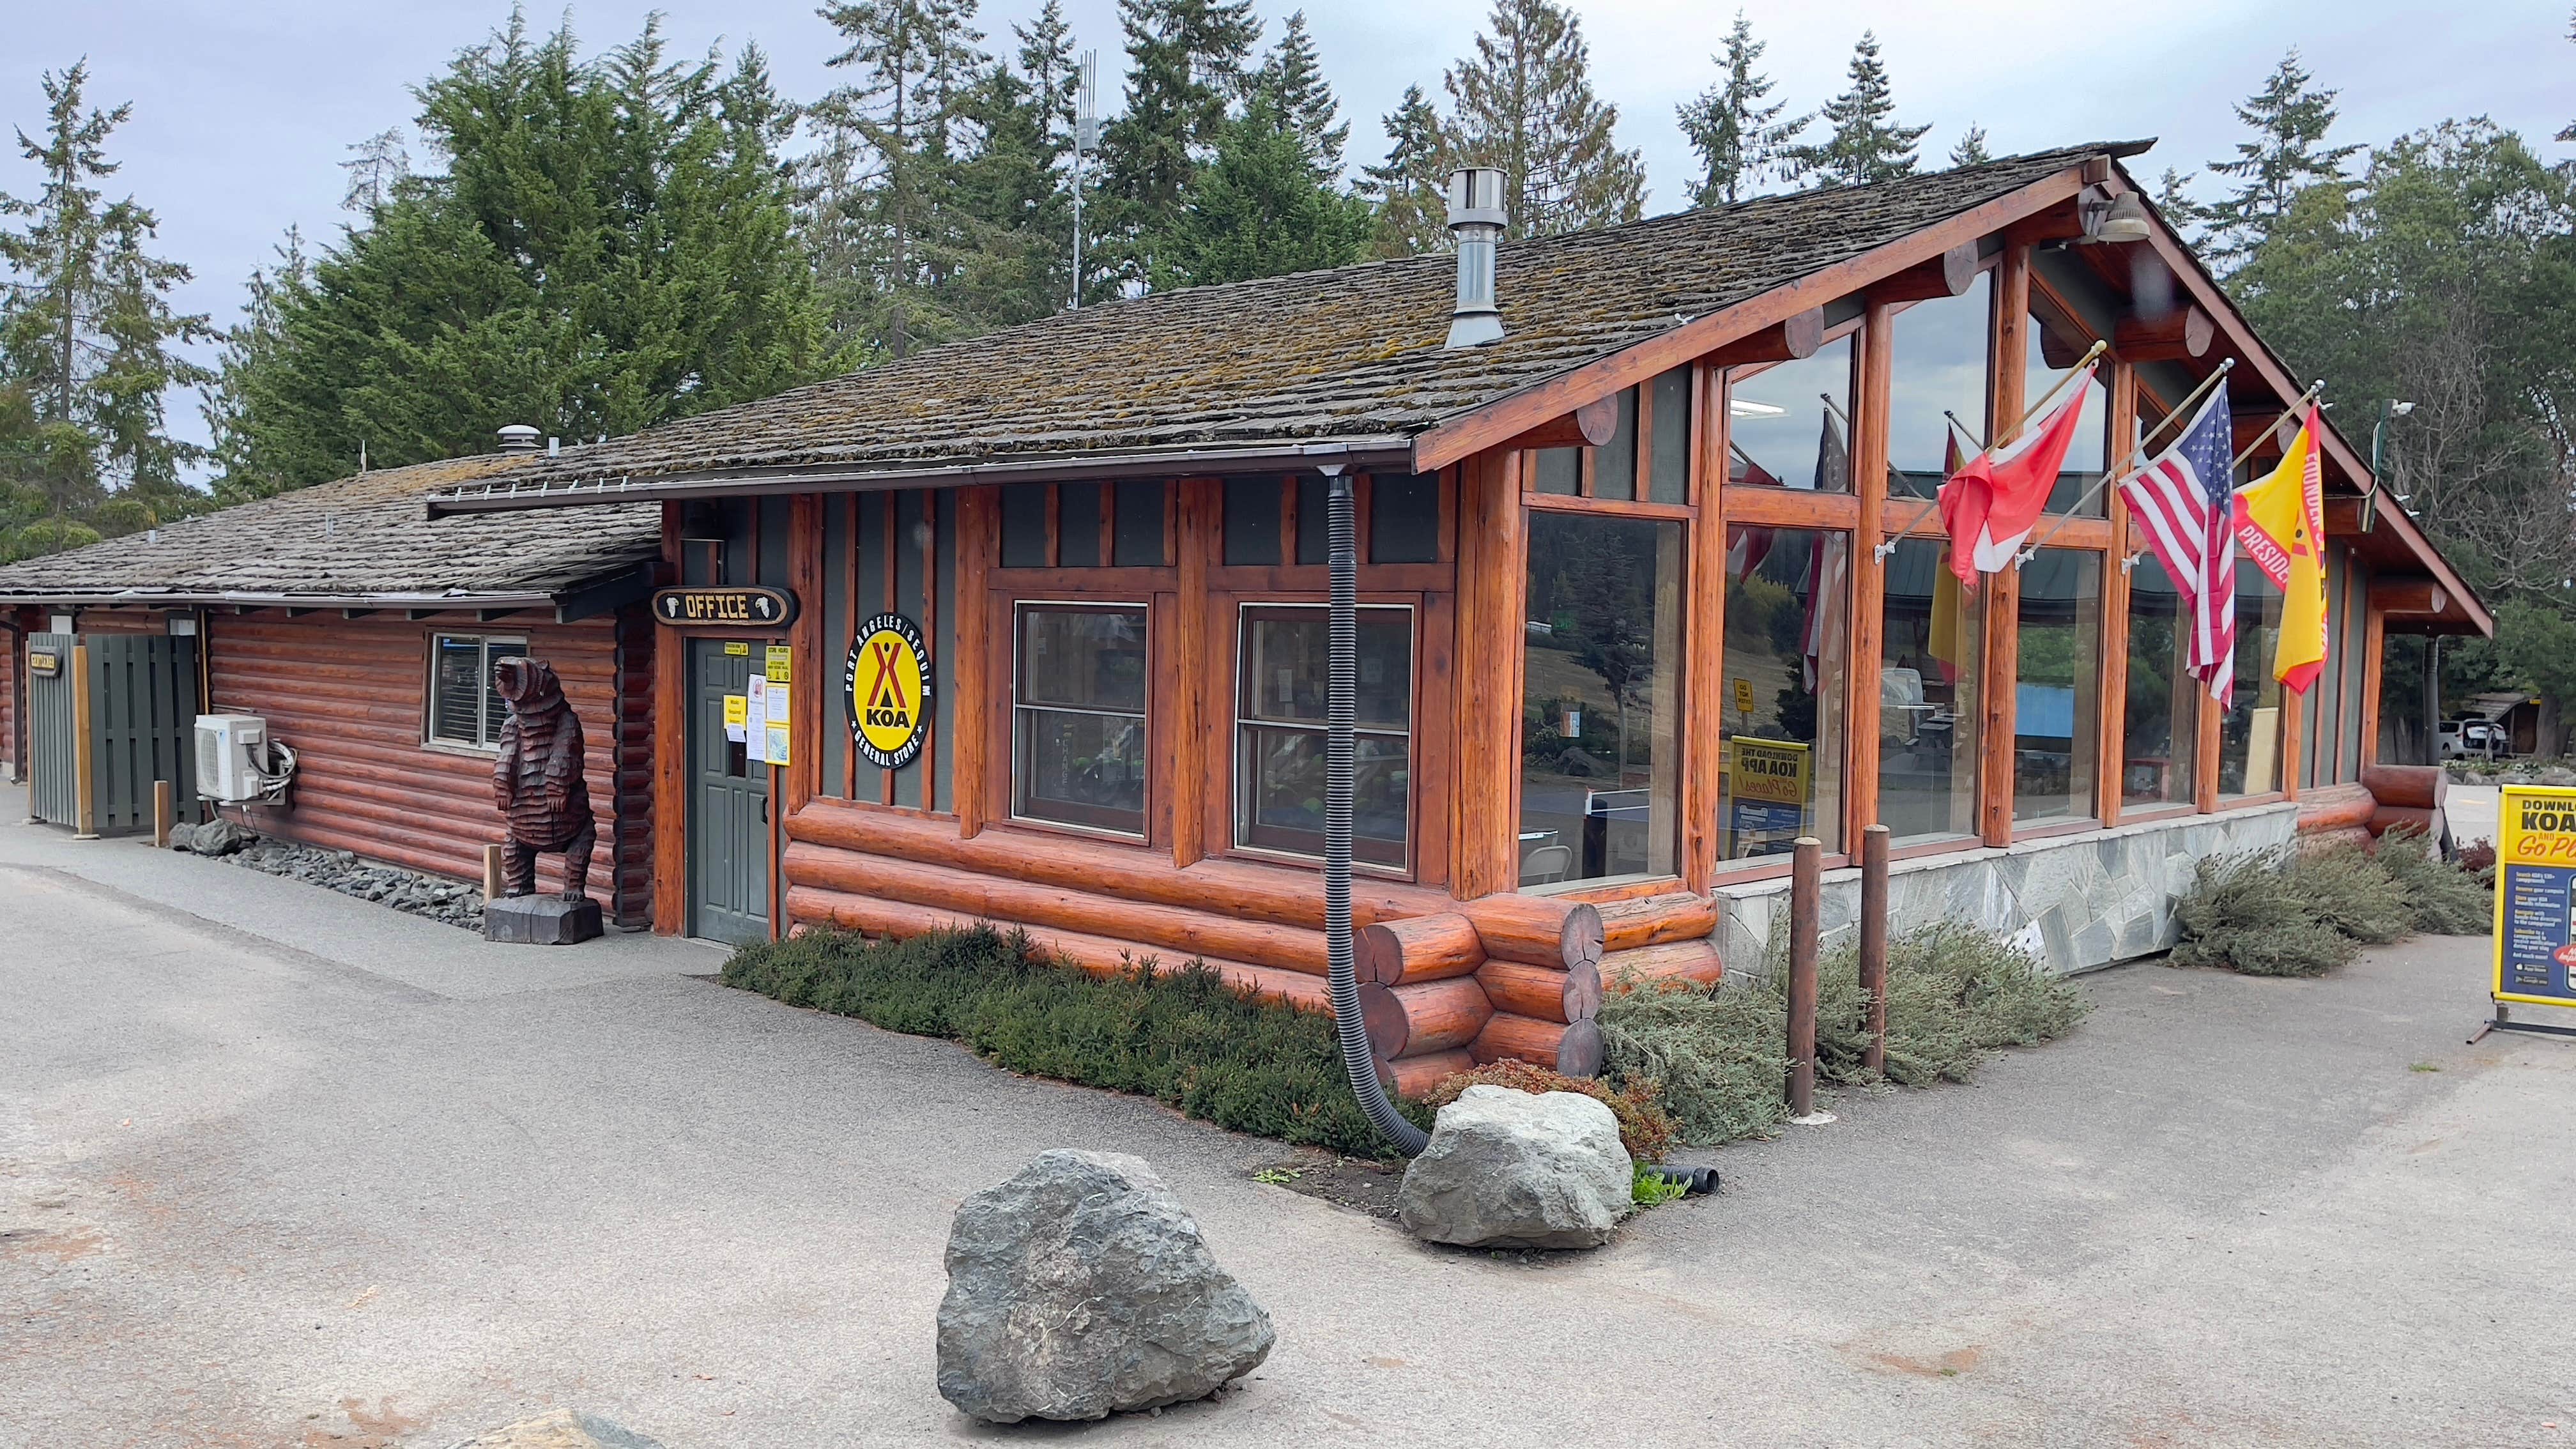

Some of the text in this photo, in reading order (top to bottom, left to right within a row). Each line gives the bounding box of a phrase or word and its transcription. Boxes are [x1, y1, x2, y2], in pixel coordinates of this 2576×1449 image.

[686, 595, 749, 618] OFFICE
[845, 649, 857, 691] PORT
[866, 709, 910, 728] KOA
[854, 730, 919, 766] GENERAL STORE
[2522, 800, 2576, 811] DOWNL
[2522, 811, 2576, 832] KOA
[2518, 835, 2546, 856] Go
[2538, 832, 2554, 841] AND
